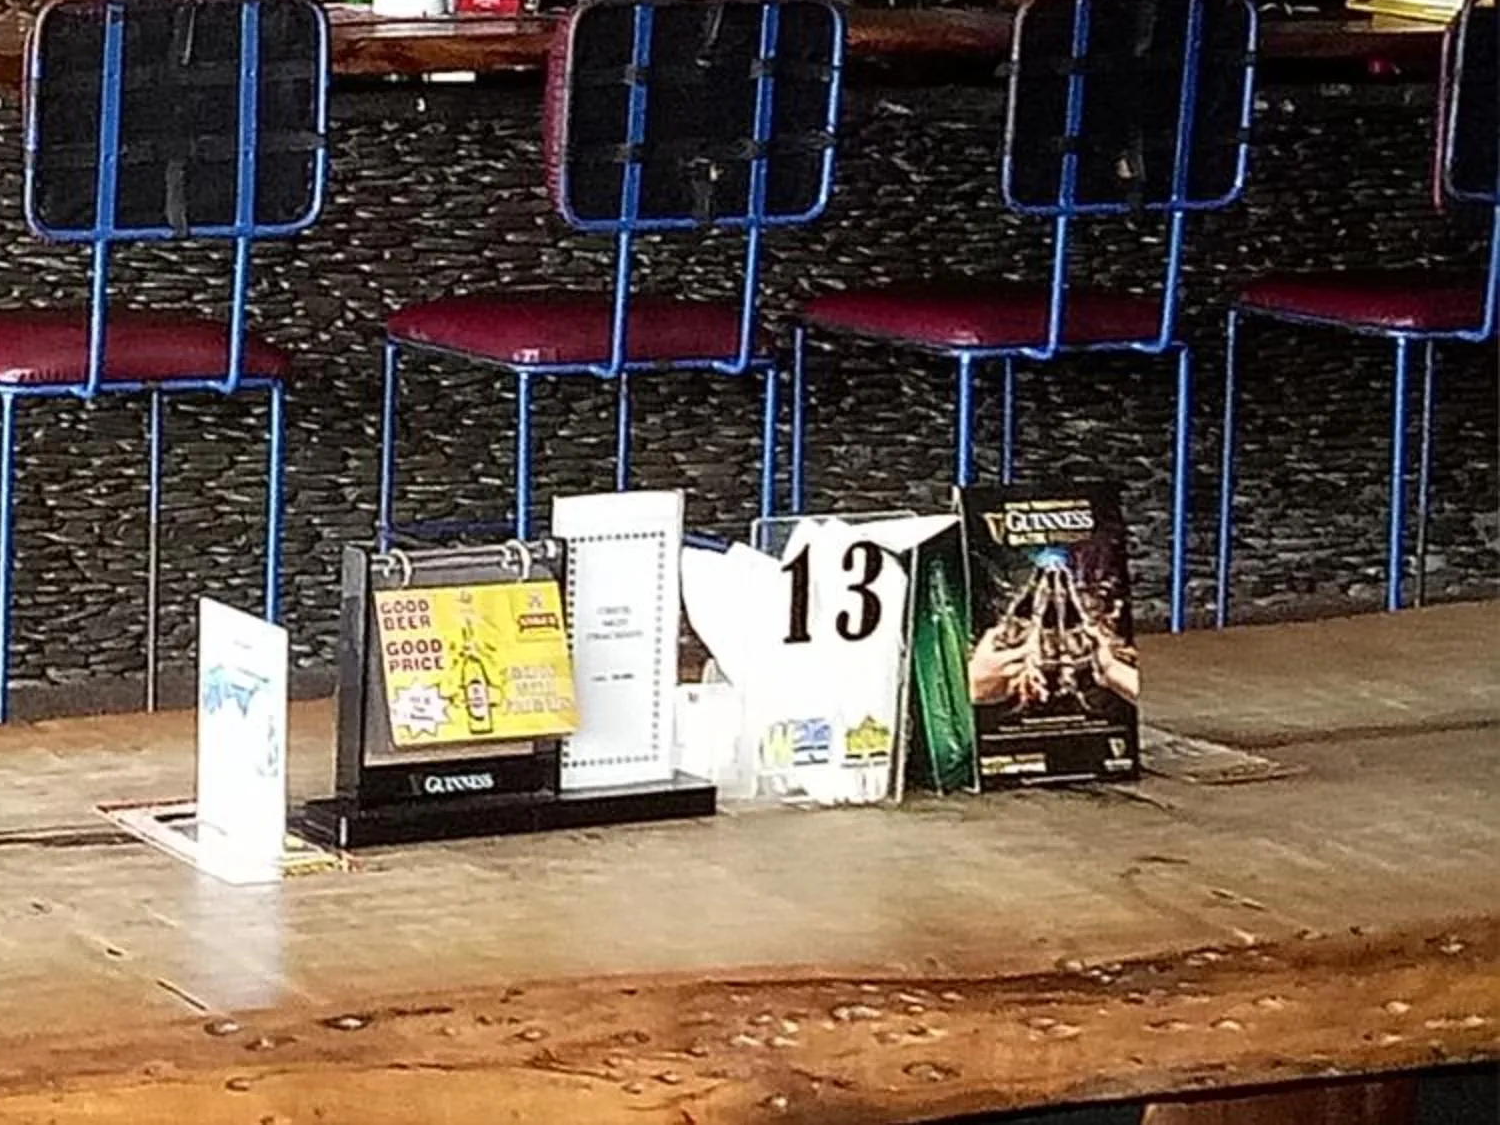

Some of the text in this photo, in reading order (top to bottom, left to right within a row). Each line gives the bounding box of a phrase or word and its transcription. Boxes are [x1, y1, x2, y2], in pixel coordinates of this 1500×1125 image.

[1006, 510, 1094, 533] GUINNESS
[781, 542, 885, 643] 13
[379, 599, 430, 615] GOOD
[383, 615, 431, 631] BEER
[386, 638, 443, 656] GOOD
[389, 655, 445, 674] PRICE
